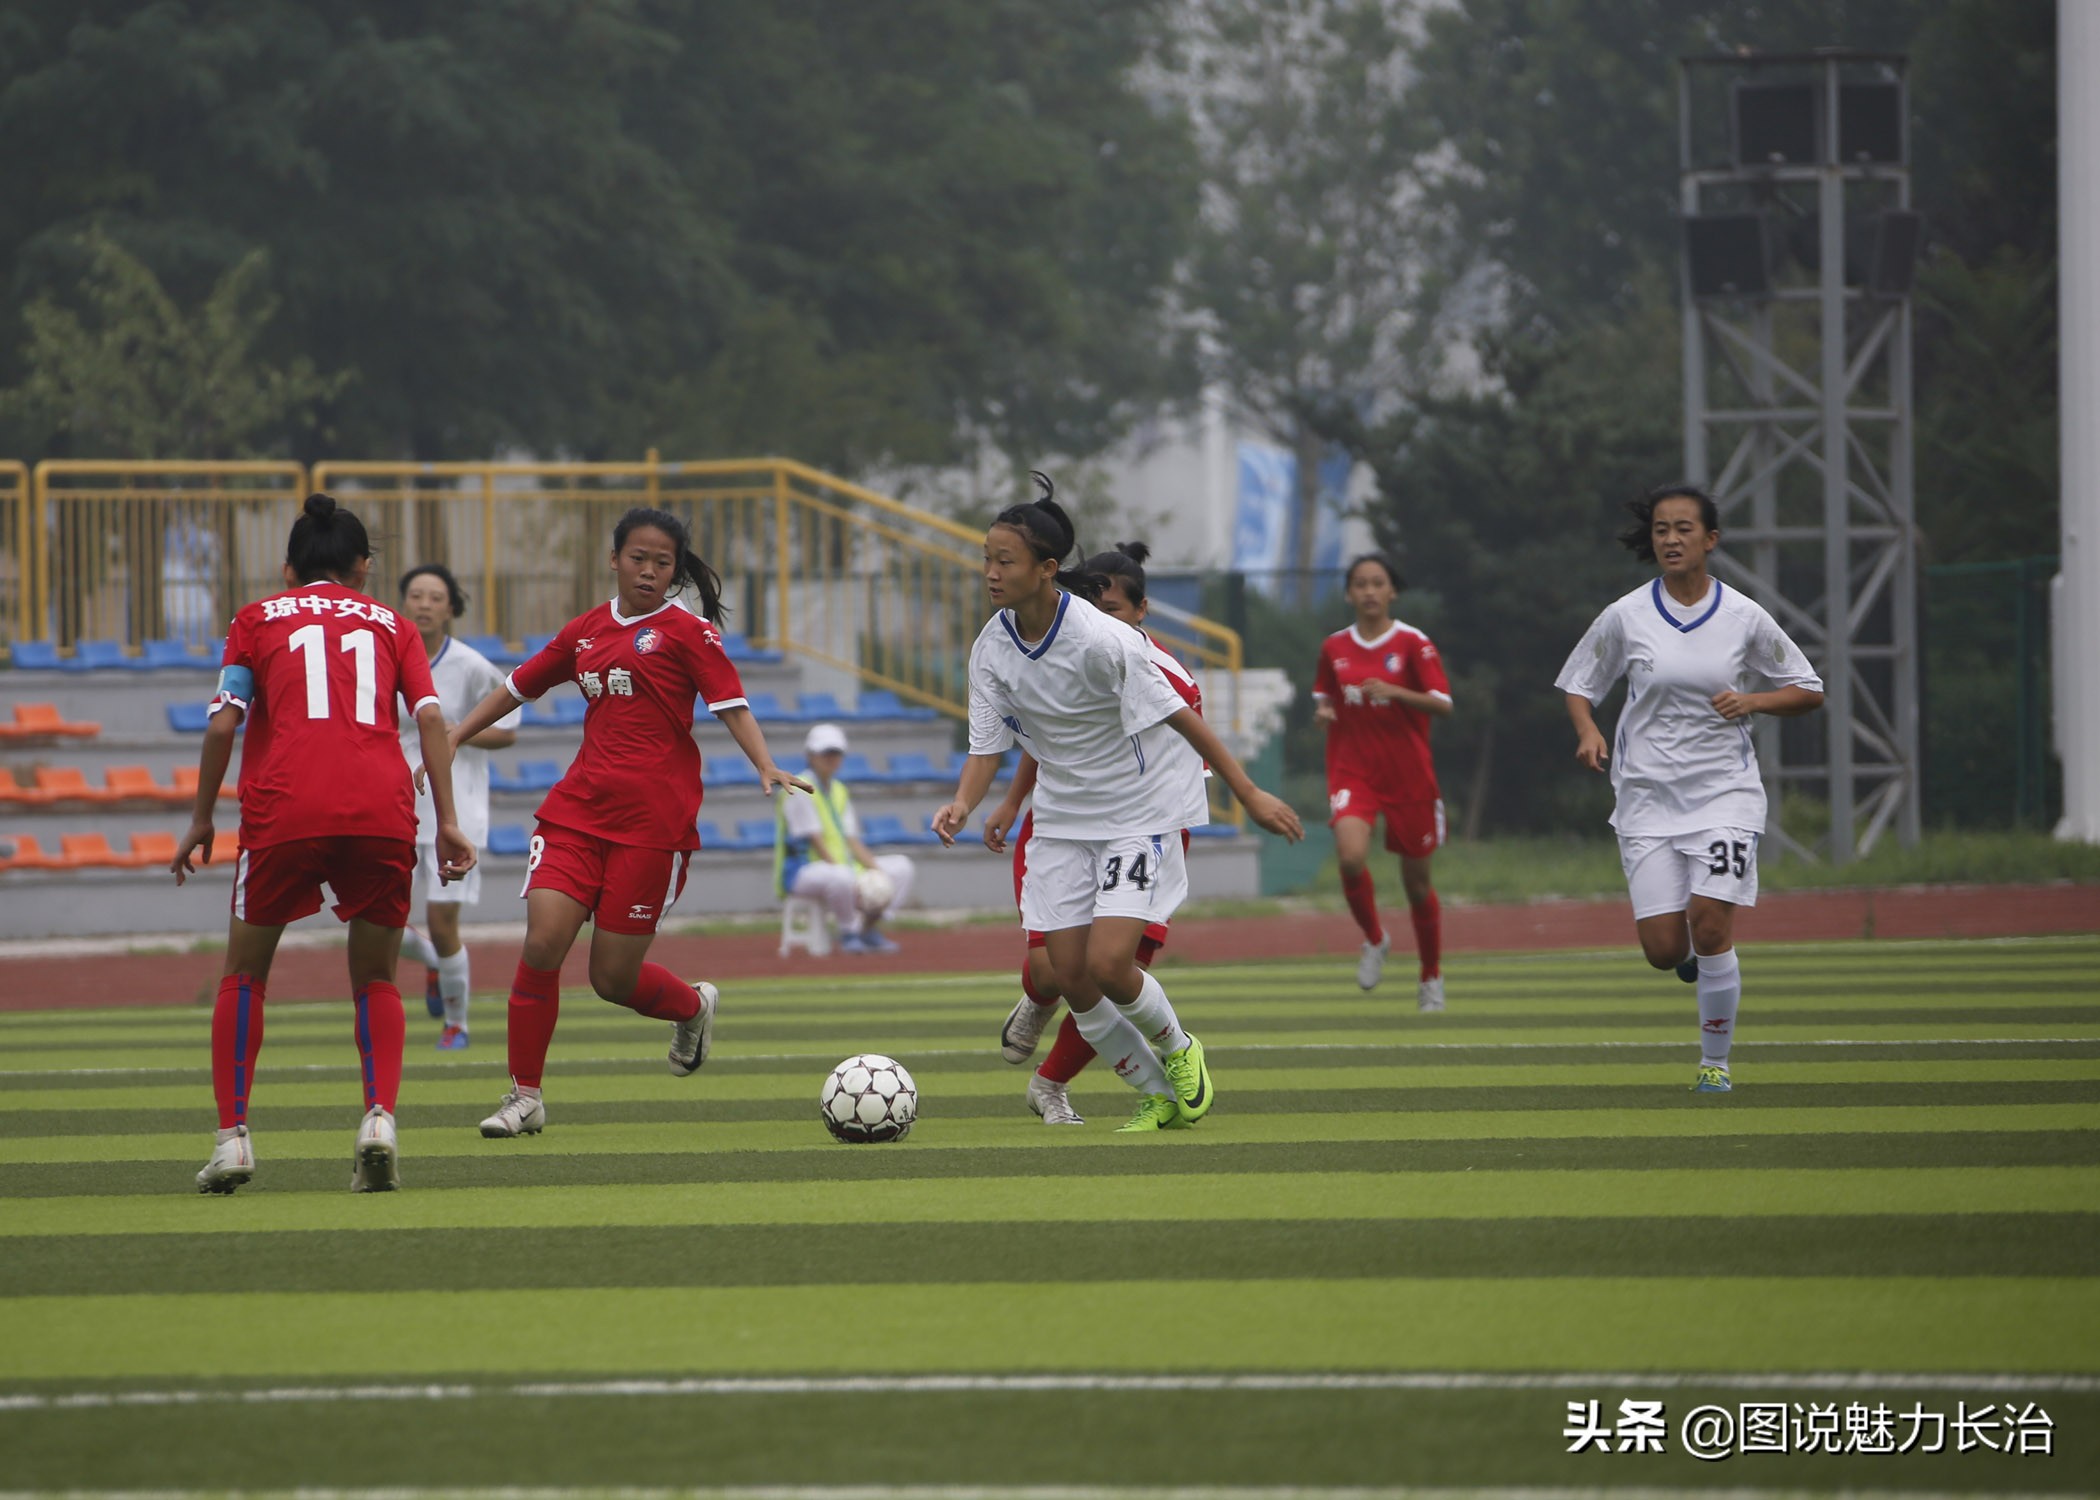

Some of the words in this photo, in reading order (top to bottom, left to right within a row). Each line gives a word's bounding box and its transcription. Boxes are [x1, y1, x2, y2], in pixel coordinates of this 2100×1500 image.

[261, 595, 397, 634] 琼中女足
[288, 624, 377, 726] 11
[578, 667, 633, 698] 海南
[1102, 851, 1150, 891] 34
[1708, 840, 1747, 879] 35
